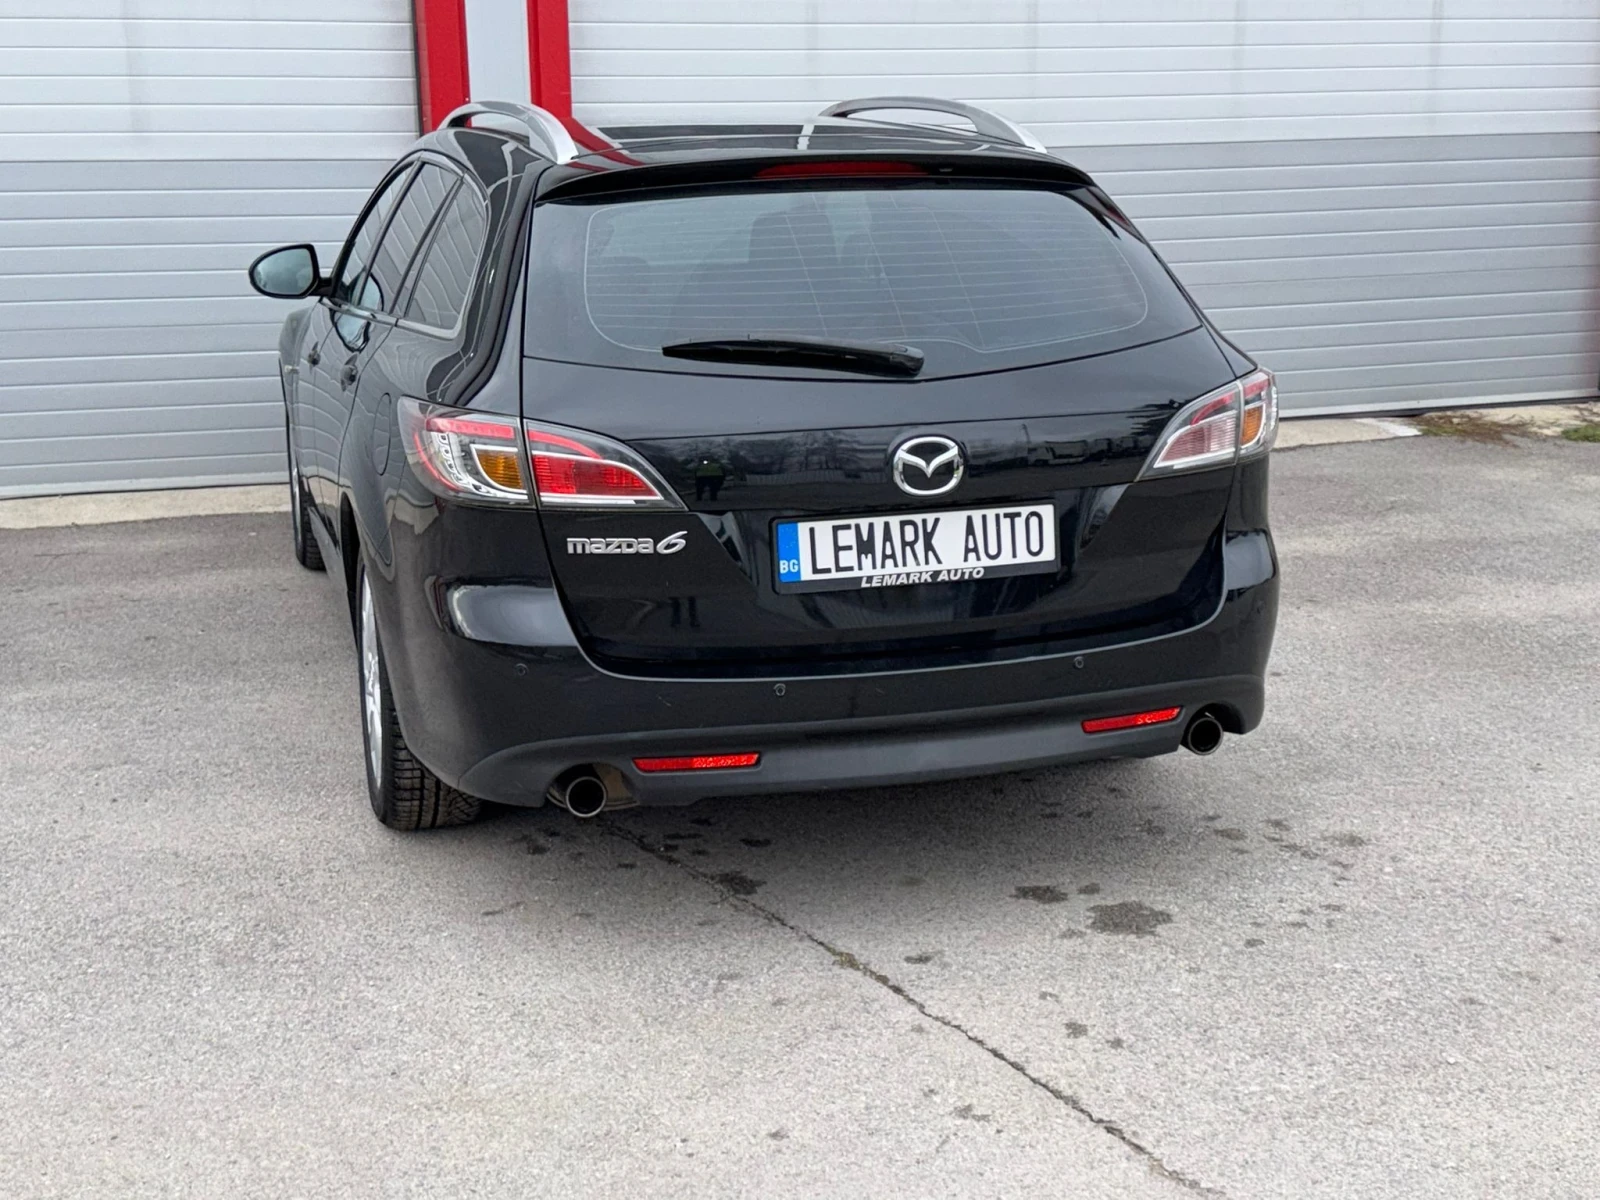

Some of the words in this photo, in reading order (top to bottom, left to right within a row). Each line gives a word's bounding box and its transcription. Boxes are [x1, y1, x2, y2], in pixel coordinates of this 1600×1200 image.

[809, 517, 943, 575] LEMARK
[963, 511, 1044, 563] AUTO
[779, 560, 799, 574] BG
[860, 571, 933, 588] LEMARK
[937, 567, 985, 581] AUTO
